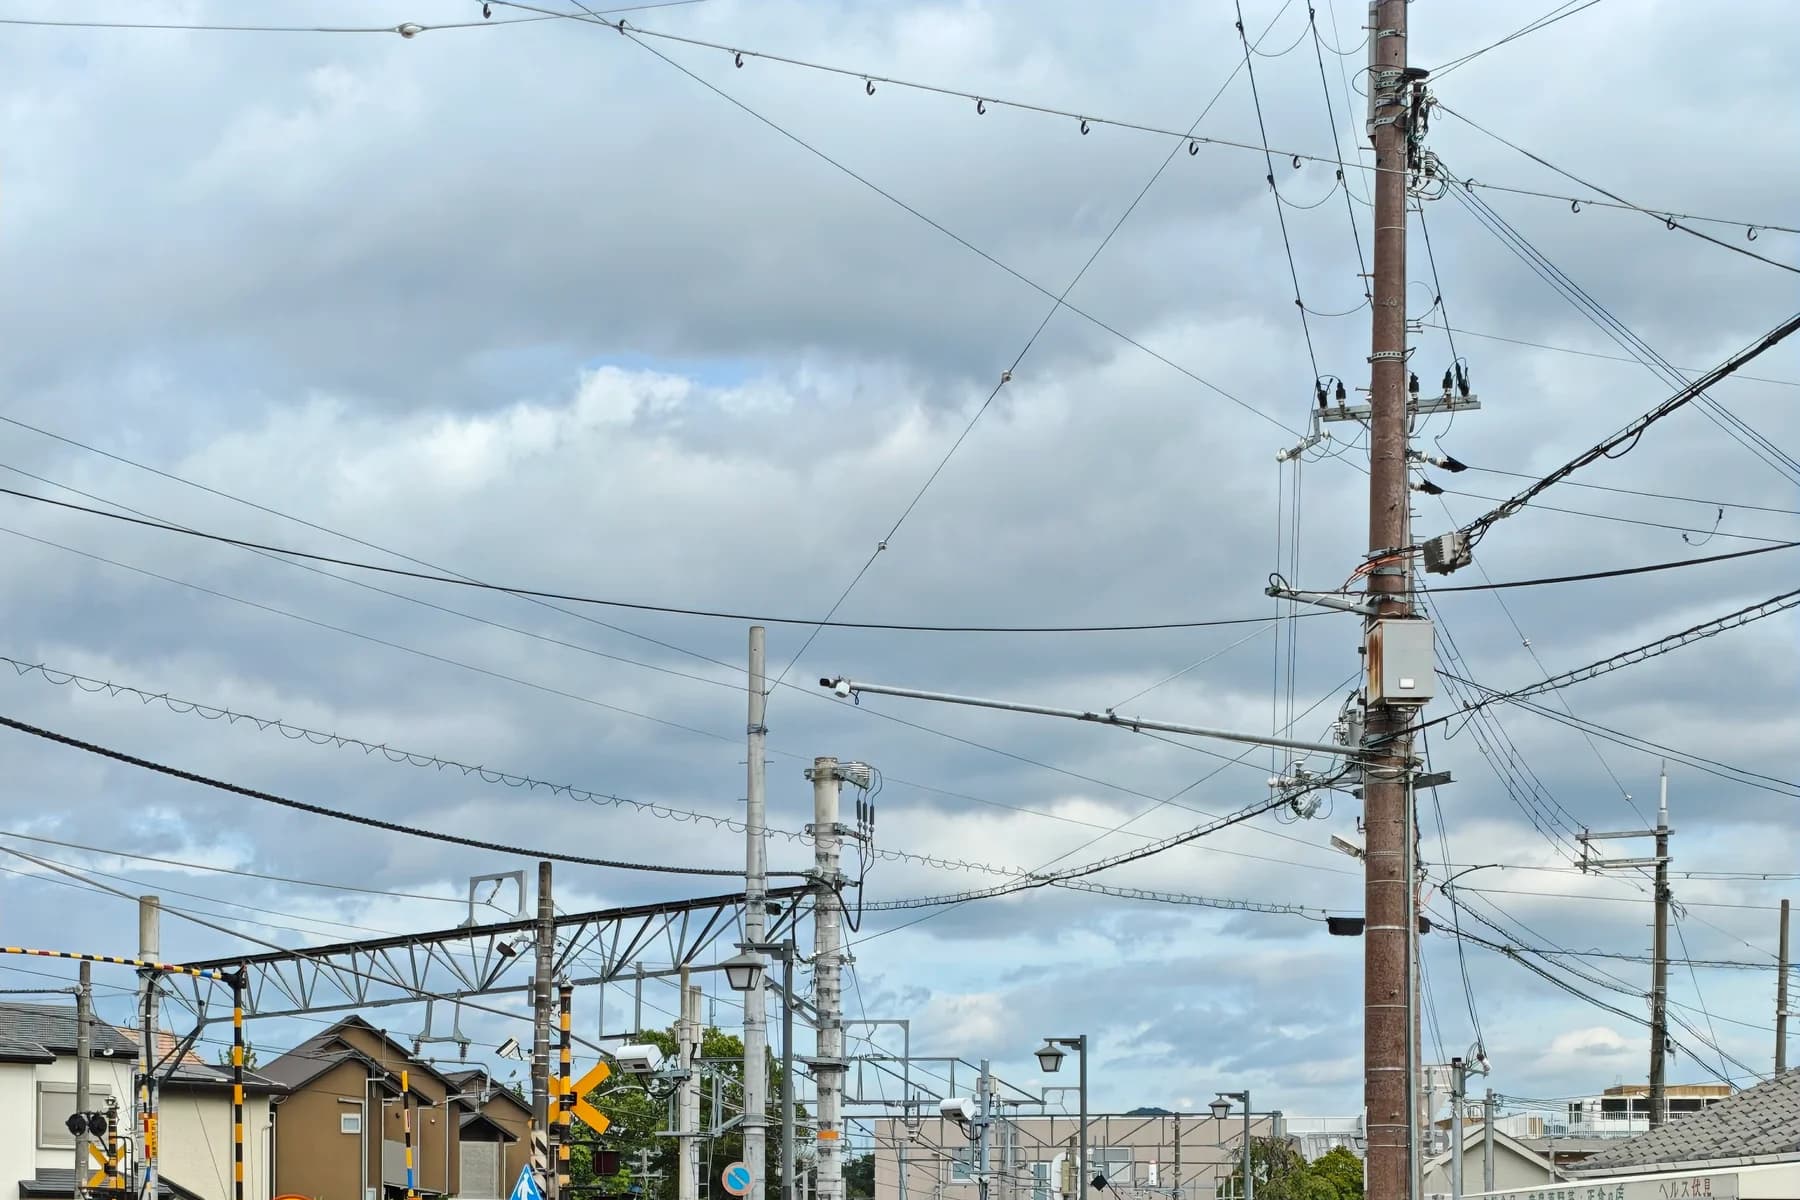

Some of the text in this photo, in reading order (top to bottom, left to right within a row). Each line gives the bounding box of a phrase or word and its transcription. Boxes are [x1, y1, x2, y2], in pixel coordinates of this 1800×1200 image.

[1659, 1177, 1712, 1198] ヘルス伏見
